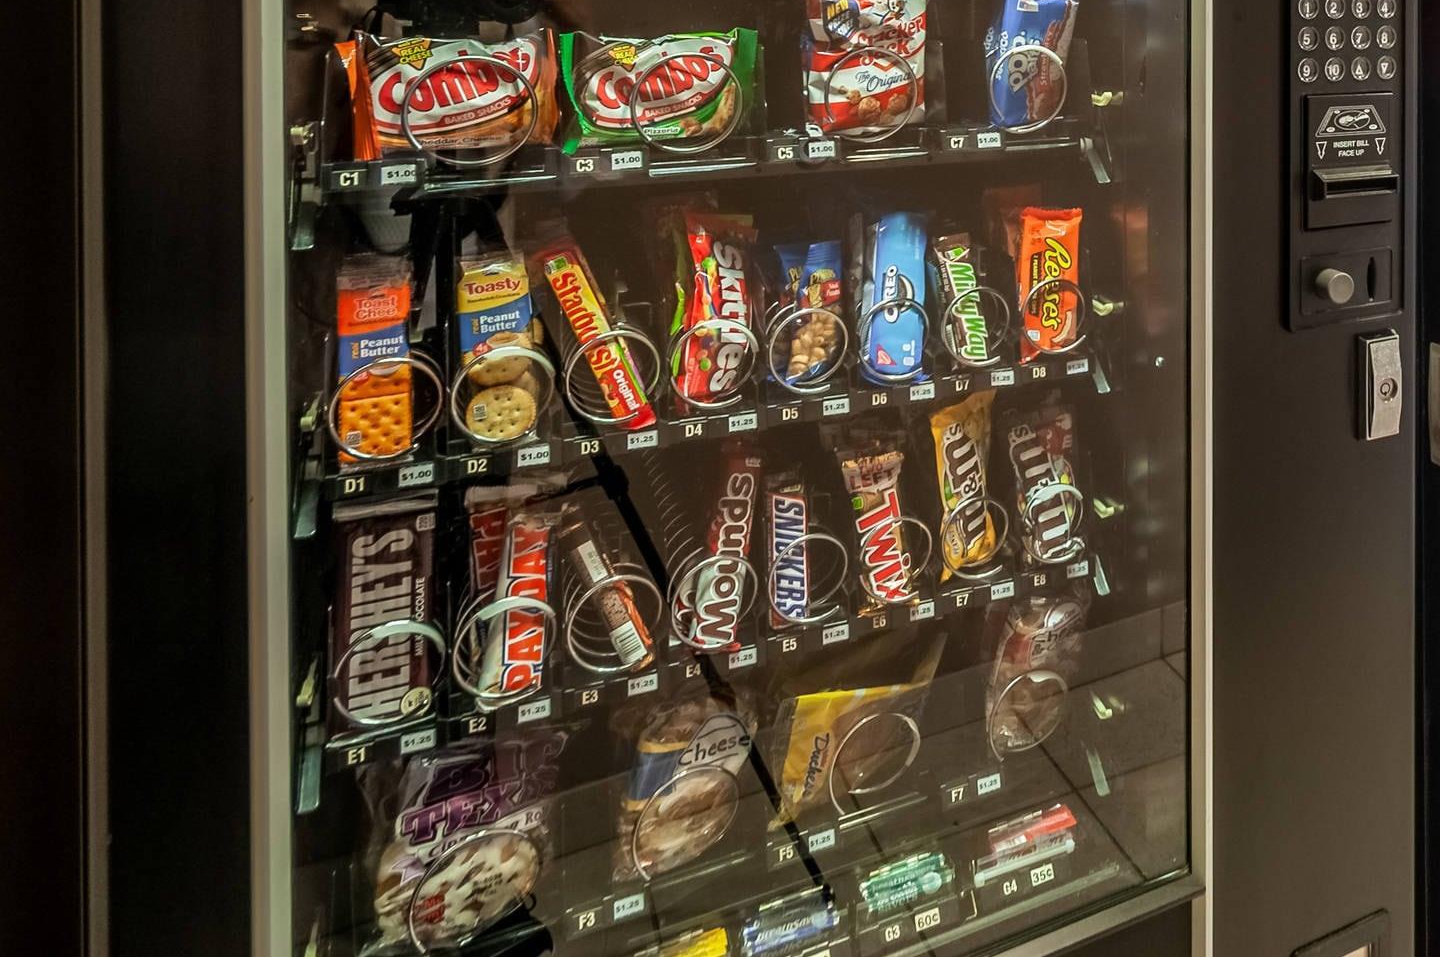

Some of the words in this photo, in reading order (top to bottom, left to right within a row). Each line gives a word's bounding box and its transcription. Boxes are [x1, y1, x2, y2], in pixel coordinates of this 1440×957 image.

[399, 51, 432, 65] CHEESE
[400, 45, 425, 57] REAL
[596, 46, 725, 110] Combos
[445, 111, 477, 124] BAKED
[477, 97, 512, 117] SNACKS
[645, 107, 671, 118] BAKED
[777, 146, 793, 159] C5
[810, 145, 834, 154] $1.00
[950, 136, 965, 149] C7
[978, 136, 999, 144] $1.00
[1333, 140, 1356, 148] INSERT
[1338, 149, 1355, 157] FACE
[1355, 148, 1365, 156] UP
[576, 160, 594, 172] C3
[614, 156, 641, 165] $1.00
[339, 171, 360, 187] C1
[464, 277, 521, 296] Toasty
[1041, 237, 1073, 331] Reese's
[354, 295, 398, 311] Toast
[882, 264, 899, 324] OREO
[479, 310, 520, 325] Peanut
[710, 241, 749, 393] Skittles
[480, 321, 517, 334] Butter
[360, 335, 404, 349] Peanut
[360, 345, 401, 358] Butter
[1032, 366, 1046, 379] D8
[612, 369, 640, 411] Original
[955, 379, 969, 392] D7
[992, 373, 1011, 383] $1.25
[872, 392, 888, 406] D6
[912, 387, 932, 397] $1.25
[782, 407, 799, 421] D5
[824, 402, 846, 412] $1.25
[685, 423, 702, 437] D4
[731, 418, 754, 427] $1.25
[581, 441, 599, 454] D3
[629, 435, 655, 444] $1.25
[467, 458, 488, 474] D2
[520, 450, 550, 461] $1.00
[344, 478, 365, 493] D1
[401, 470, 432, 481] $1.00
[850, 467, 896, 490] LEFT
[773, 497, 806, 619] SNICKERS
[1034, 574, 1046, 587] E8
[956, 595, 969, 607] E7
[992, 587, 1013, 596] $1.25
[872, 615, 886, 628] E6
[782, 640, 798, 653] E5
[824, 629, 847, 639] $1.25
[686, 664, 701, 678] E4
[730, 653, 754, 664] $1.25
[582, 691, 599, 705] E3
[629, 678, 655, 688] $1.25
[468, 718, 487, 734] E2
[520, 705, 547, 716] $1.25
[347, 748, 366, 764] E1
[403, 735, 432, 746] $1.25
[678, 734, 751, 767] Cheese
[950, 788, 964, 802] F7
[978, 779, 999, 791] $1.25
[779, 847, 794, 862] F5
[810, 835, 831, 847] $1.25
[1003, 880, 1018, 895] G4
[578, 914, 596, 930] F3
[615, 900, 640, 911] $1.25
[885, 925, 901, 941] G3
